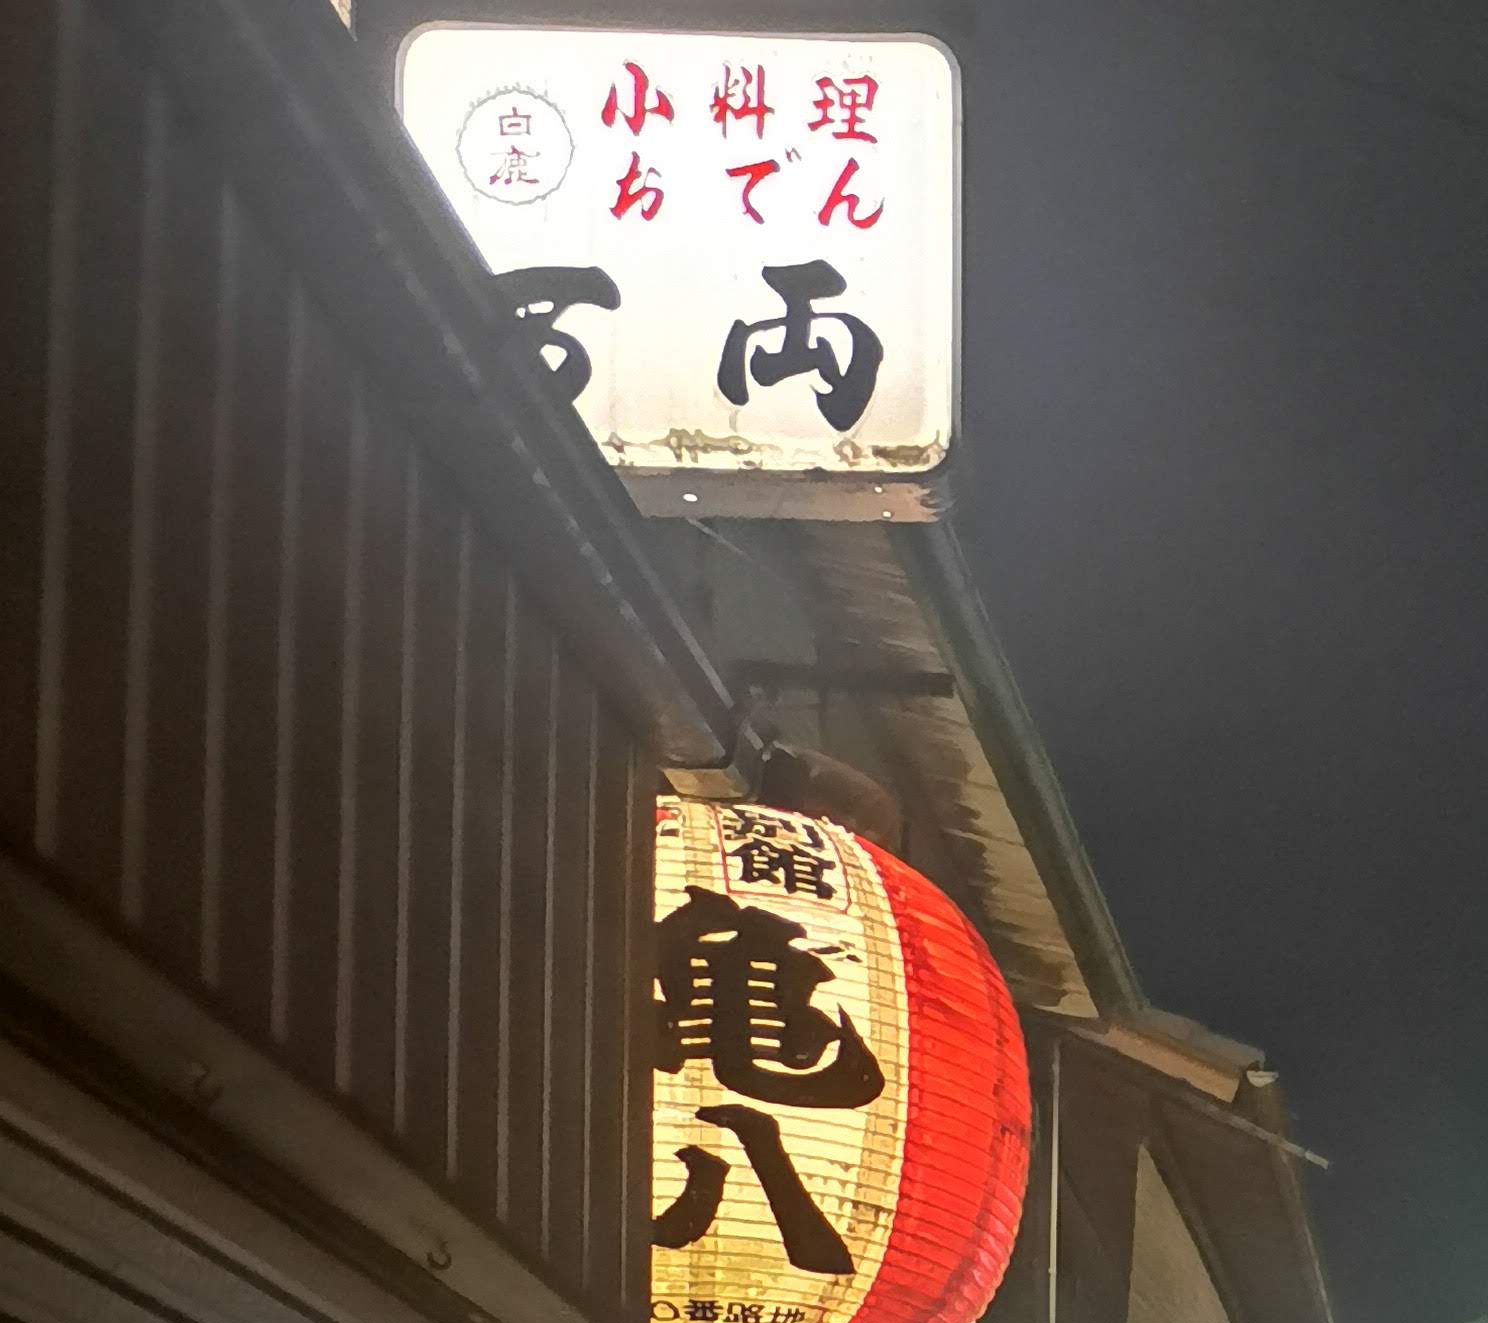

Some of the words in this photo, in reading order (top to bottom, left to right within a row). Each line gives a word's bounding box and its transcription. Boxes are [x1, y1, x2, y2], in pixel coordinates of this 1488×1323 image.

[600, 62, 880, 146] 小料理
[488, 106, 542, 187] 白鹿
[608, 146, 885, 230] おでん
